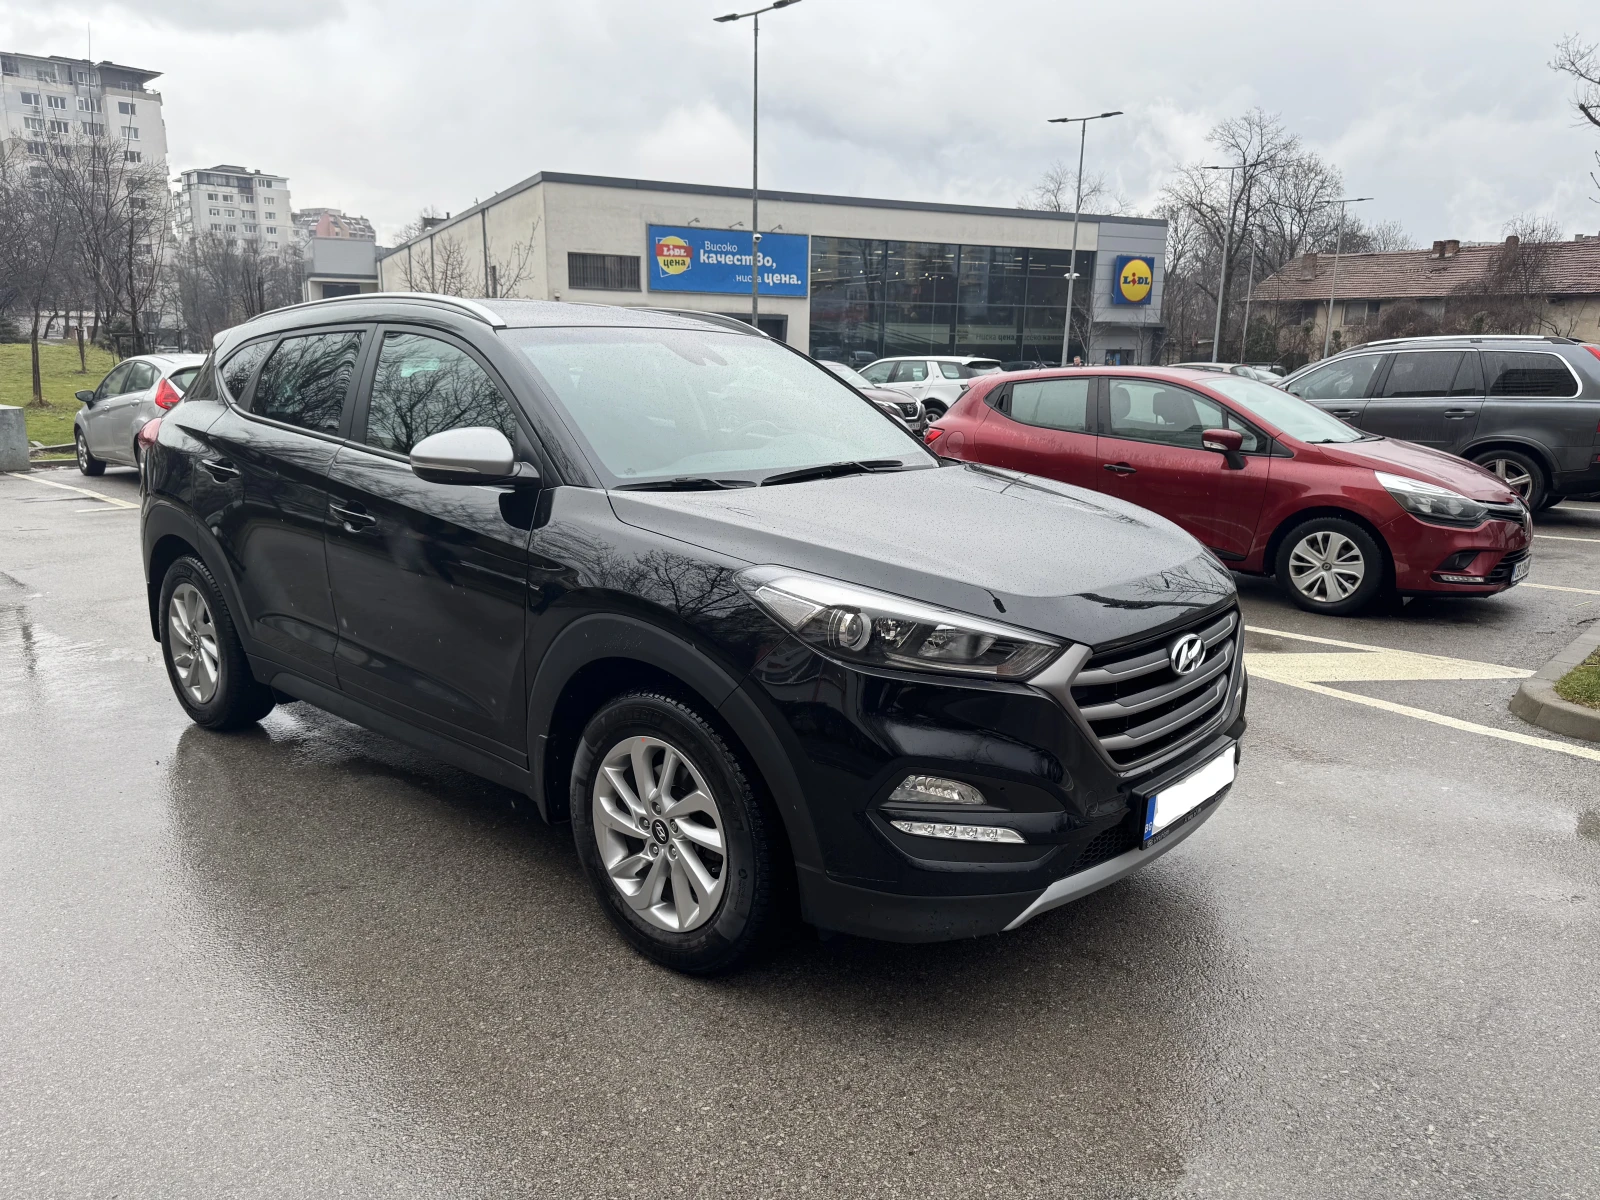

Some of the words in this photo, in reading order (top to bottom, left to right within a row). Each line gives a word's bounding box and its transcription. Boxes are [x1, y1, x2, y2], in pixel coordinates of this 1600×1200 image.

[705, 241, 738, 252] Високо
[663, 259, 686, 268] цена
[736, 274, 762, 282] ниса
[764, 273, 801, 286] цена.
